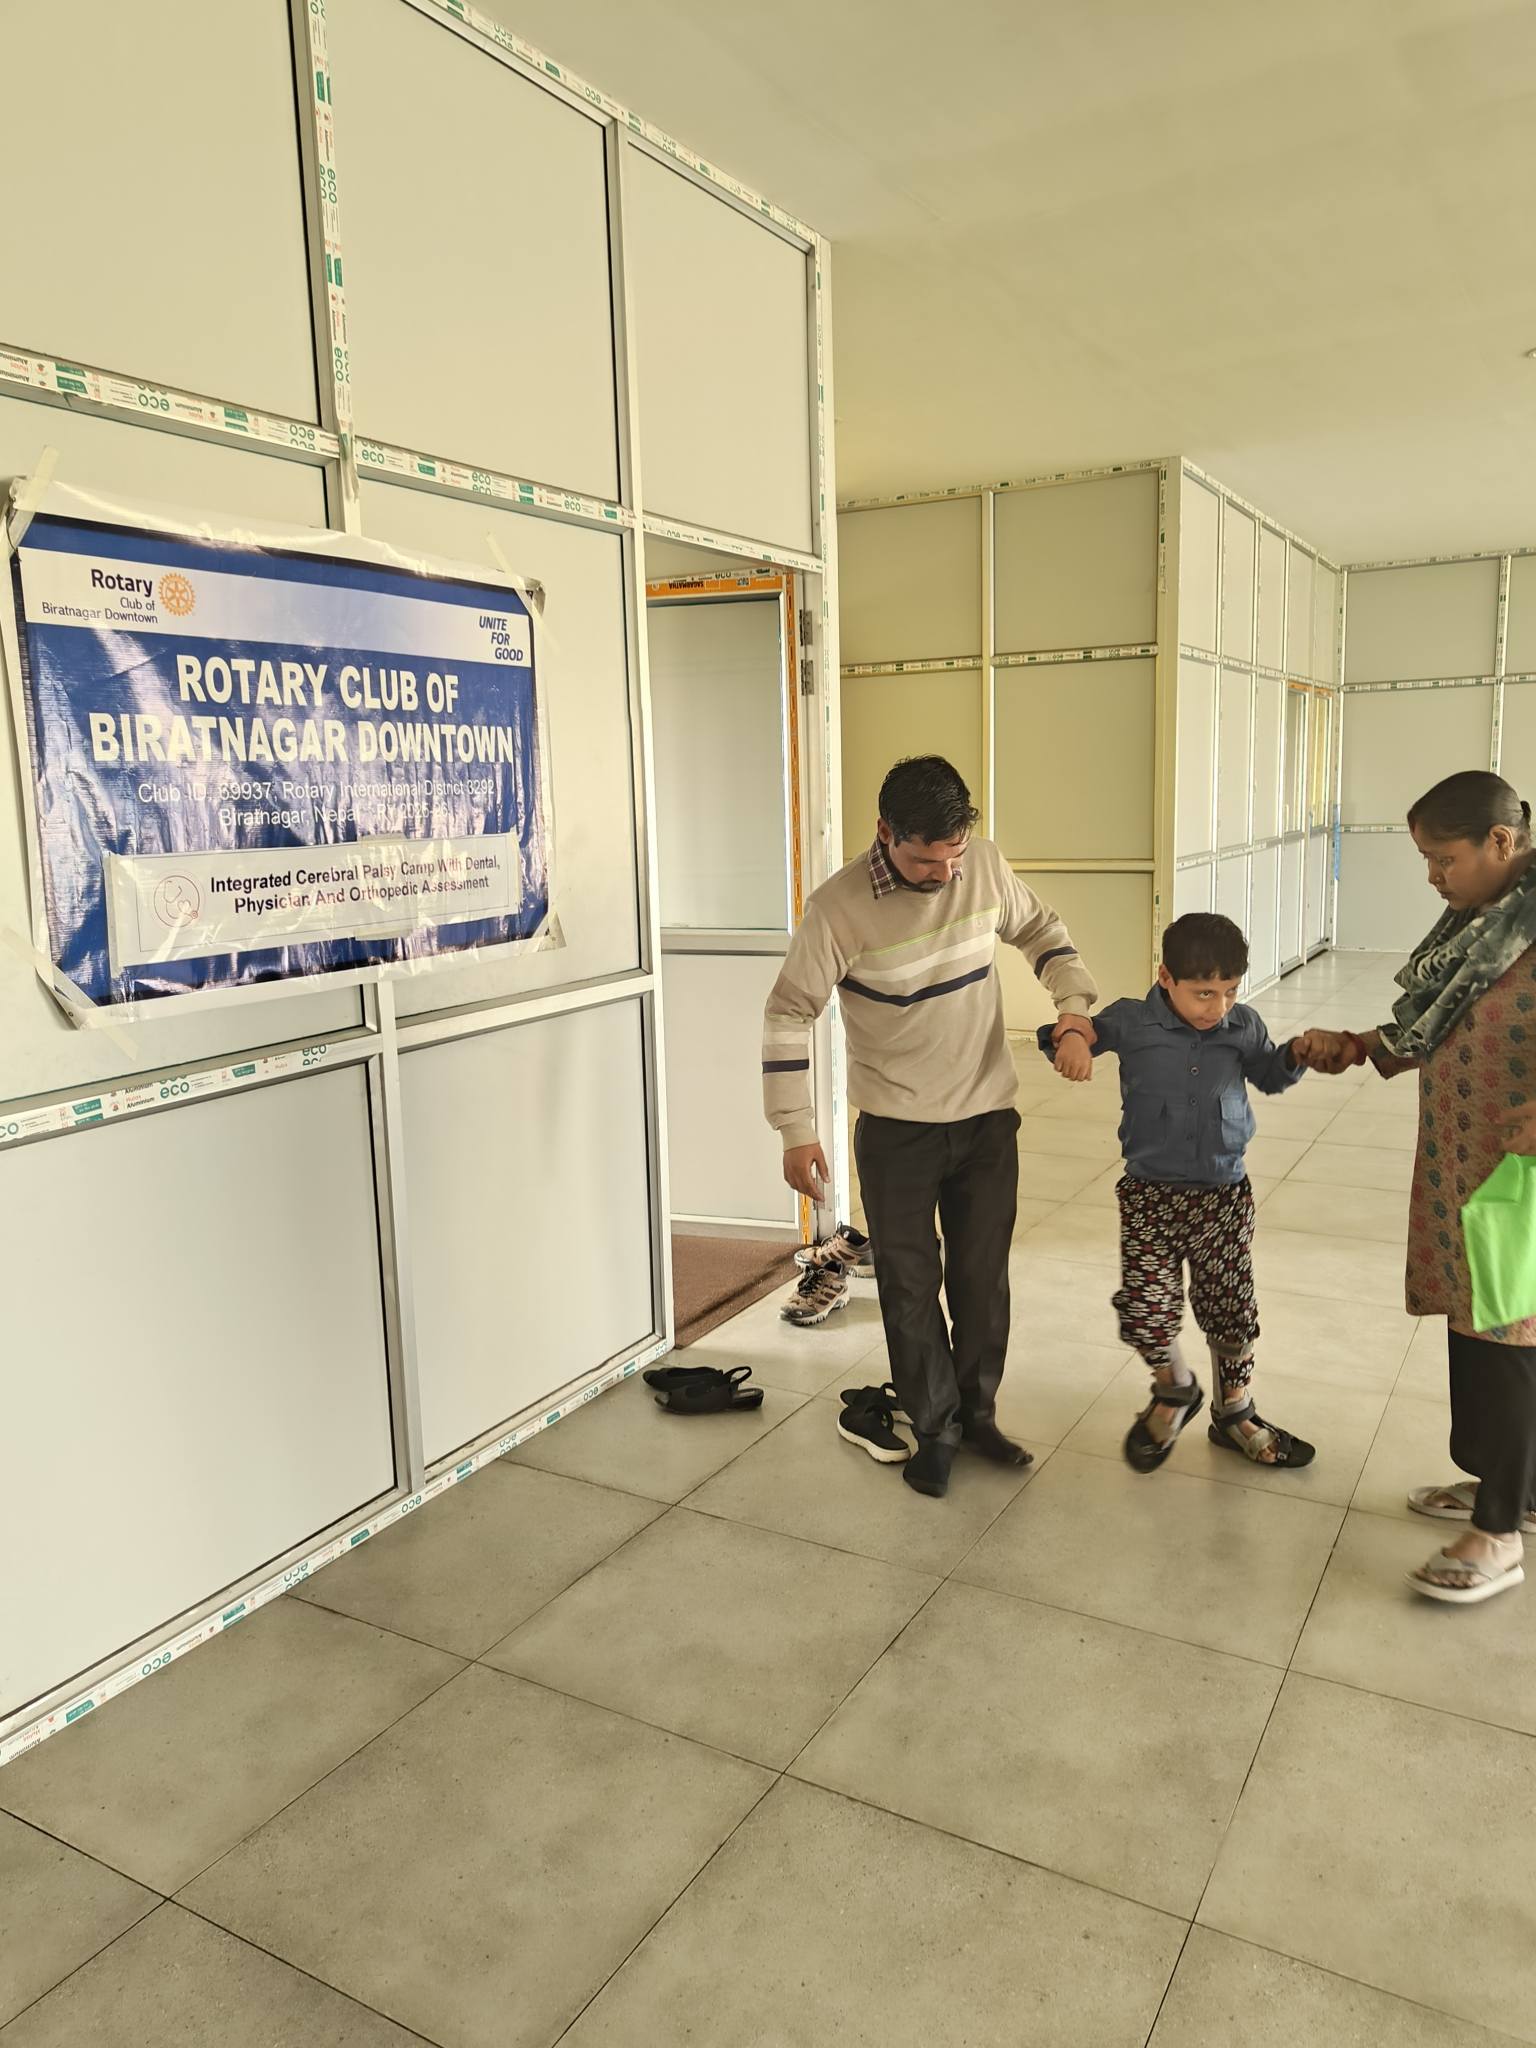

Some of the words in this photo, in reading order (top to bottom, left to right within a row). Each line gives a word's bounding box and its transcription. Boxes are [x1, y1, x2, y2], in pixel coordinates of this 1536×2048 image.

[327, 168, 338, 204] eco
[333, 347, 344, 382] eco
[138, 393, 170, 411] eco
[289, 423, 315, 440] eco
[361, 449, 385, 464] eco
[471, 471, 491, 485] eco
[564, 499, 581, 512] eco
[91, 568, 153, 597] Rotary
[668, 580, 705, 590] SAGARMATHA
[42, 602, 101, 621] Biratnagar
[105, 608, 159, 624] Downtown
[120, 597, 143, 611] Club
[145, 599, 156, 612] of
[479, 615, 508, 632] UNITE
[491, 632, 511, 646] FOR
[495, 647, 524, 662] GOOD
[176, 654, 328, 707] ROTARY
[339, 665, 419, 712] CLUB
[426, 672, 459, 714] OF
[89, 712, 350, 763] BIRATNAGAR
[357, 720, 514, 764] DOWNTOWN
[138, 783, 181, 803] Club
[283, 781, 334, 802] Rotary
[340, 780, 421, 799] International
[425, 779, 465, 796] District
[468, 779, 495, 795] 3292
[220, 807, 310, 829] Biratnagar,
[211, 870, 291, 894] Integrated
[296, 865, 359, 885] Cerebral
[363, 862, 395, 881] Palsy
[401, 861, 435, 877] Camp
[438, 858, 462, 873] With
[466, 855, 500, 870] Dental,
[235, 894, 311, 915] Physician
[315, 887, 345, 906] And
[350, 881, 418, 901] Orthopedic
[422, 877, 489, 894] Assessment
[160, 1081, 190, 1099] eco
[0, 1122, 19, 1138] co
[401, 1494, 422, 1514] eco
[141, 1651, 172, 1676] eco
